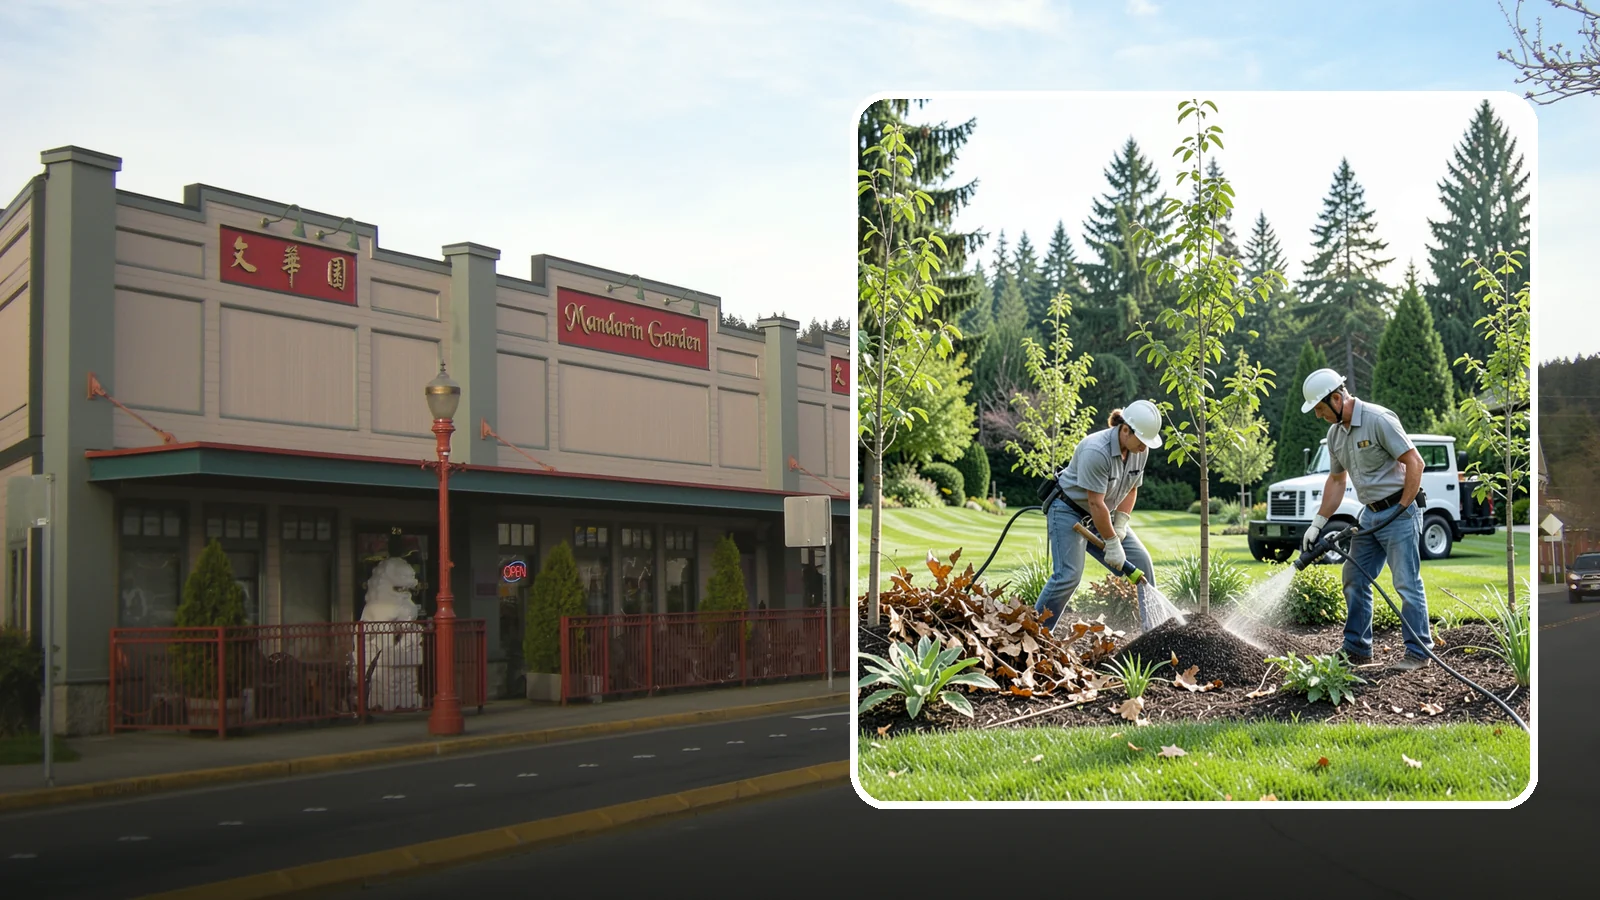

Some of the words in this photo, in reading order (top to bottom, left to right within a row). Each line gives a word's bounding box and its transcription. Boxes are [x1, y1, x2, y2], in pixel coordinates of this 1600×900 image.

[231, 236, 345, 290] 文華園
[565, 302, 644, 341] Mandarin
[648, 320, 701, 352] Garden
[503, 566, 527, 578] OPEN
